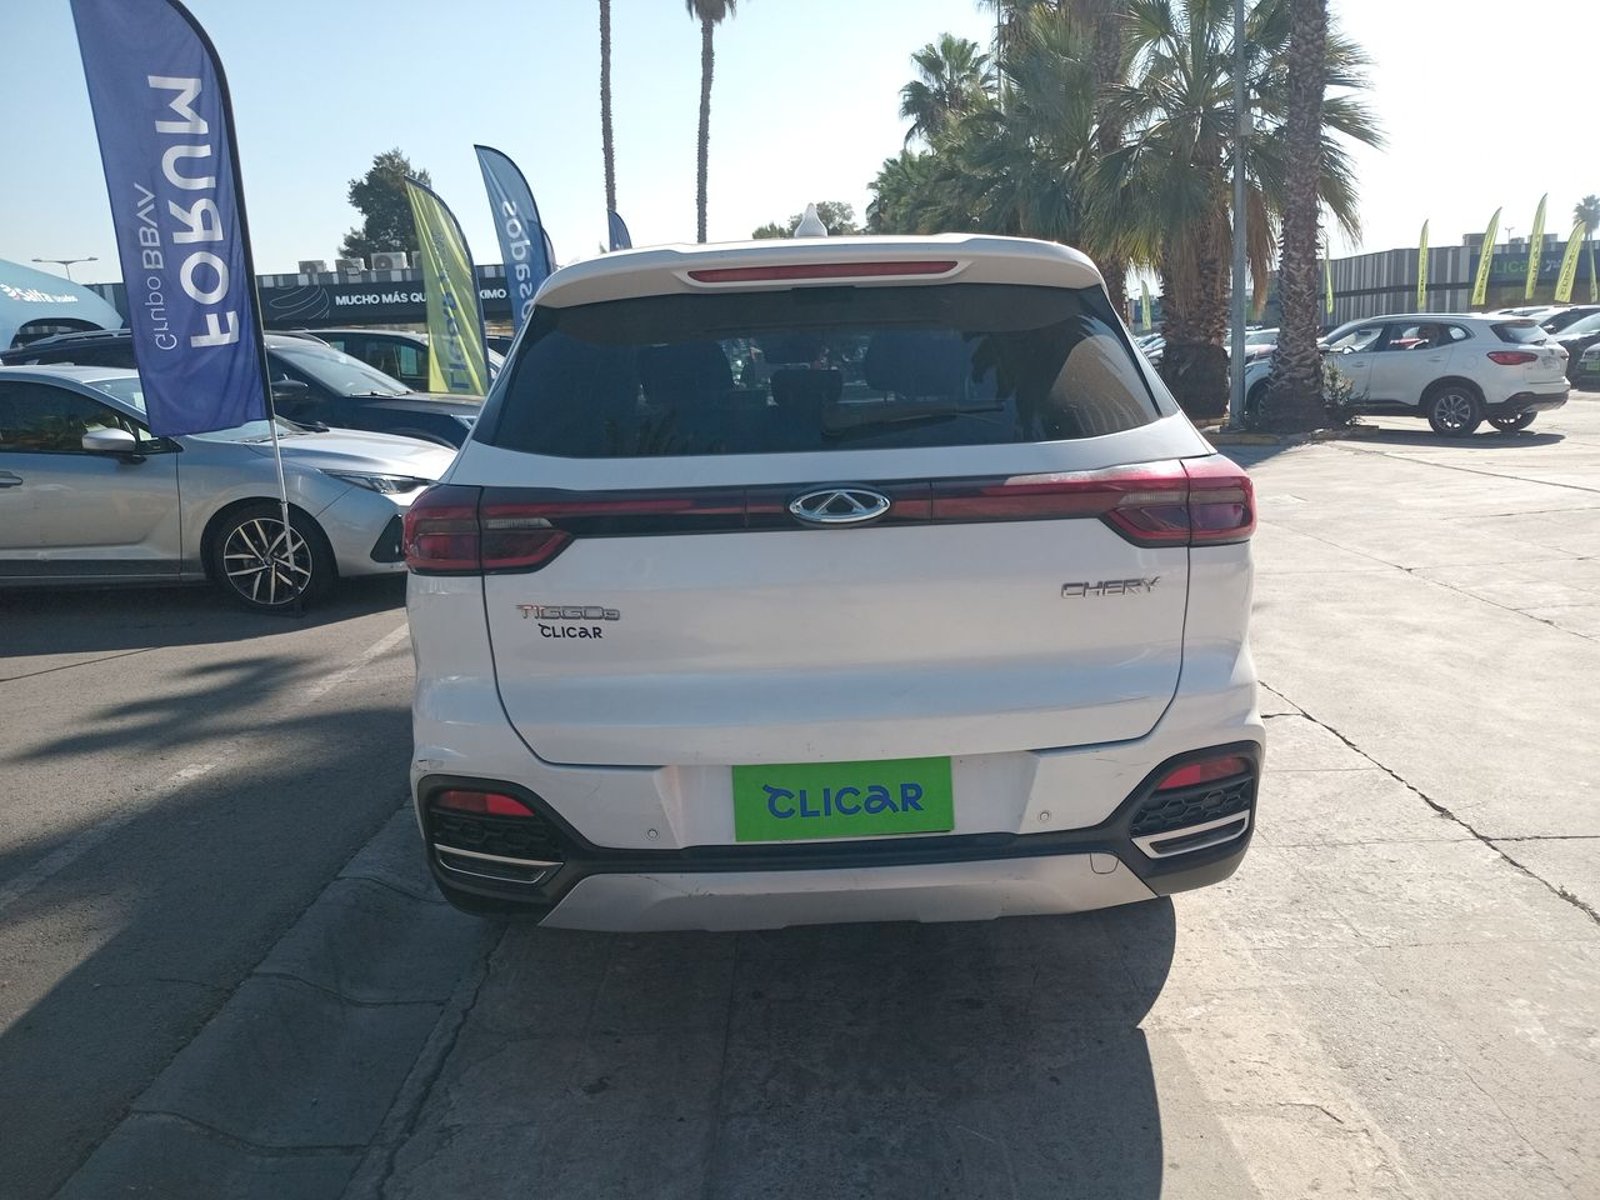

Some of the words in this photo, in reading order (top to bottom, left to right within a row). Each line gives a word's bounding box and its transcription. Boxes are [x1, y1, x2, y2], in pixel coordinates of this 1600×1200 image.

[335, 294, 380, 306] MUCHO
[381, 290, 408, 304] MÁS
[410, 292, 427, 303] QU
[1061, 576, 1160, 599] CHERY
